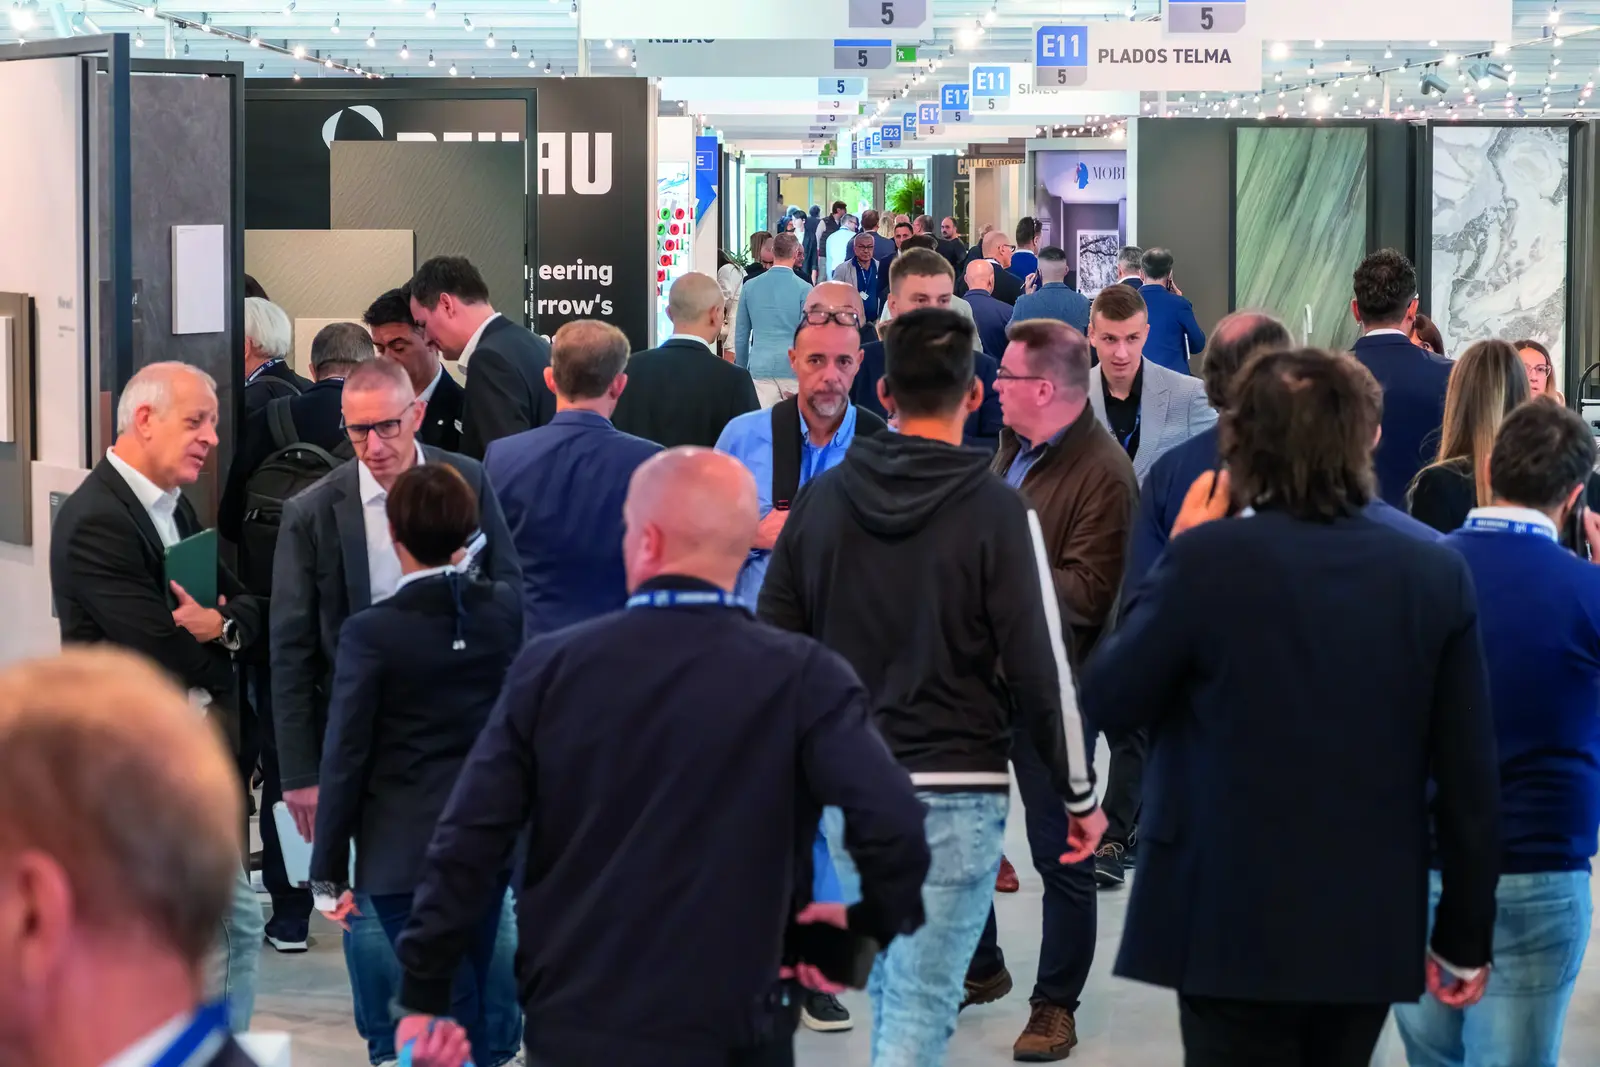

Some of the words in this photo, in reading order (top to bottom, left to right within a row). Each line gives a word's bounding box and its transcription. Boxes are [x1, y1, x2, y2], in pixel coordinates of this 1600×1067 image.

[881, 2, 894, 25] 5
[1200, 7, 1214, 30] 5
[1042, 34, 1079, 57] E11
[858, 49, 868, 67] 5
[1098, 48, 1168, 64] PLADOS
[1172, 48, 1232, 64] TELMA
[976, 72, 1005, 90] E11
[1057, 69, 1067, 84] 5
[837, 79, 845, 94] 5
[945, 89, 969, 105] E17
[988, 98, 995, 110] 5
[955, 111, 961, 122] 5
[883, 127, 900, 138] E23
[929, 126, 935, 135] 5
[538, 258, 613, 287] eering
